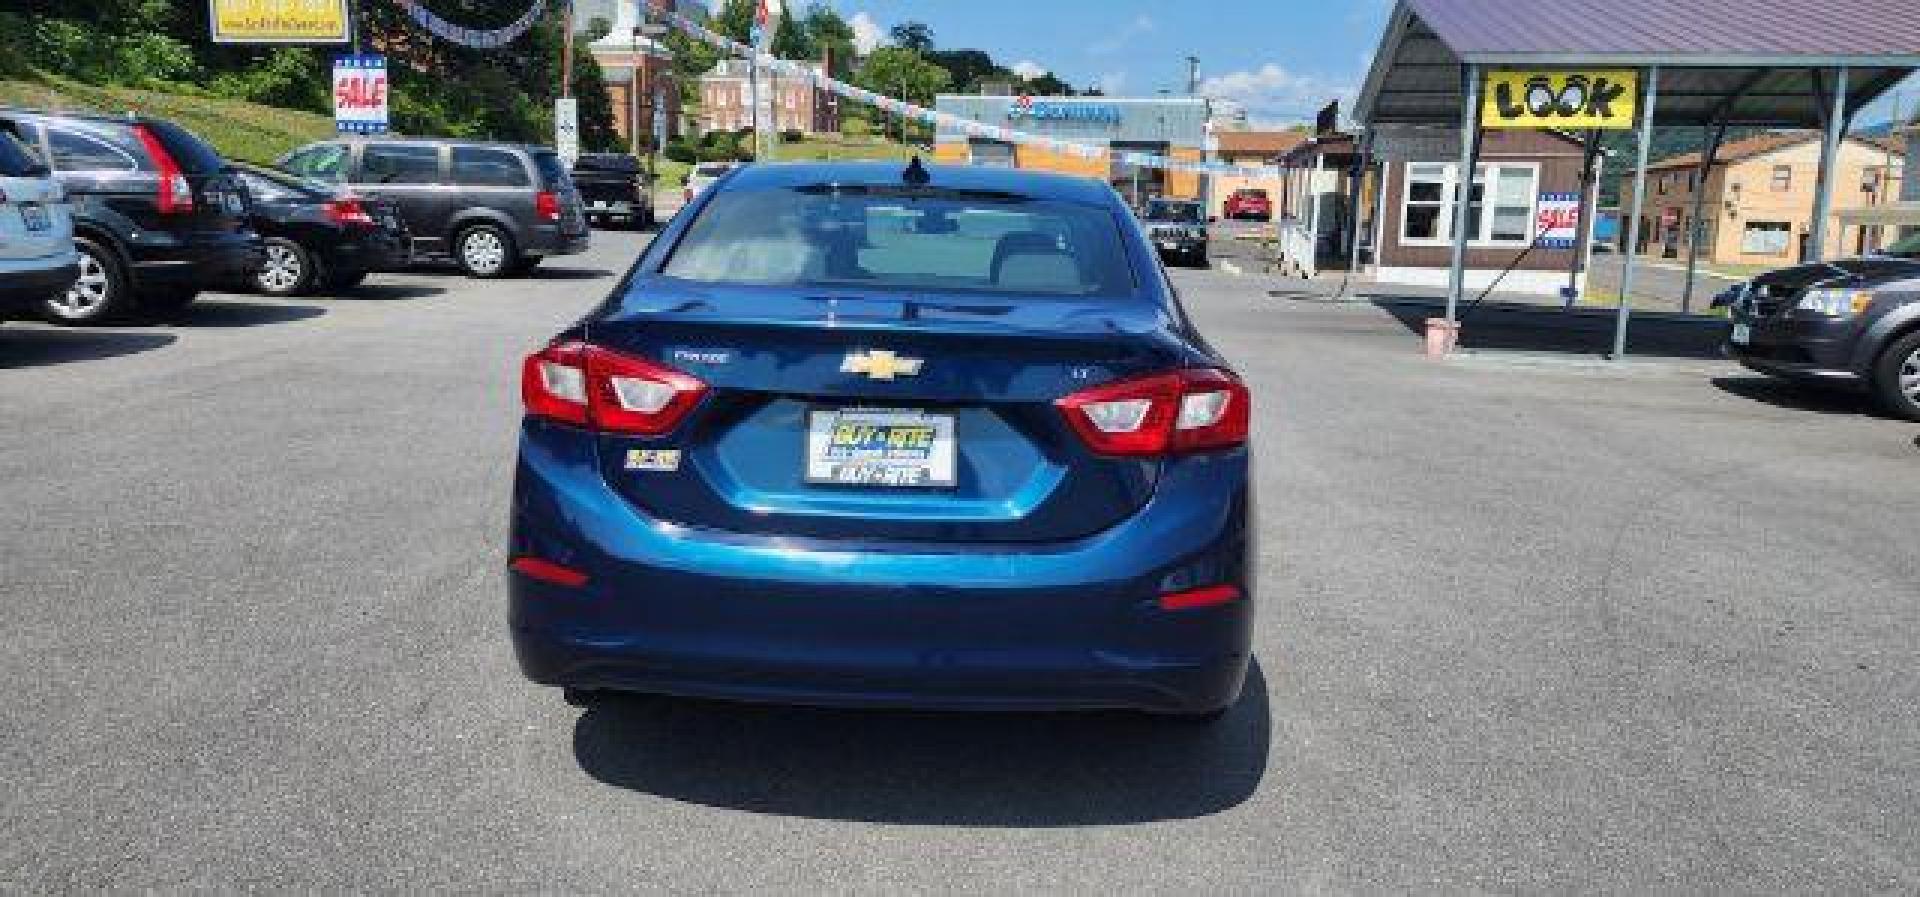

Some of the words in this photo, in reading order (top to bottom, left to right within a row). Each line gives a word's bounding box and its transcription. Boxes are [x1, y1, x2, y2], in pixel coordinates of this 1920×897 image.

[336, 76, 386, 108] SALE
[1496, 76, 1627, 120] LOOK
[1537, 206, 1579, 229] SALE
